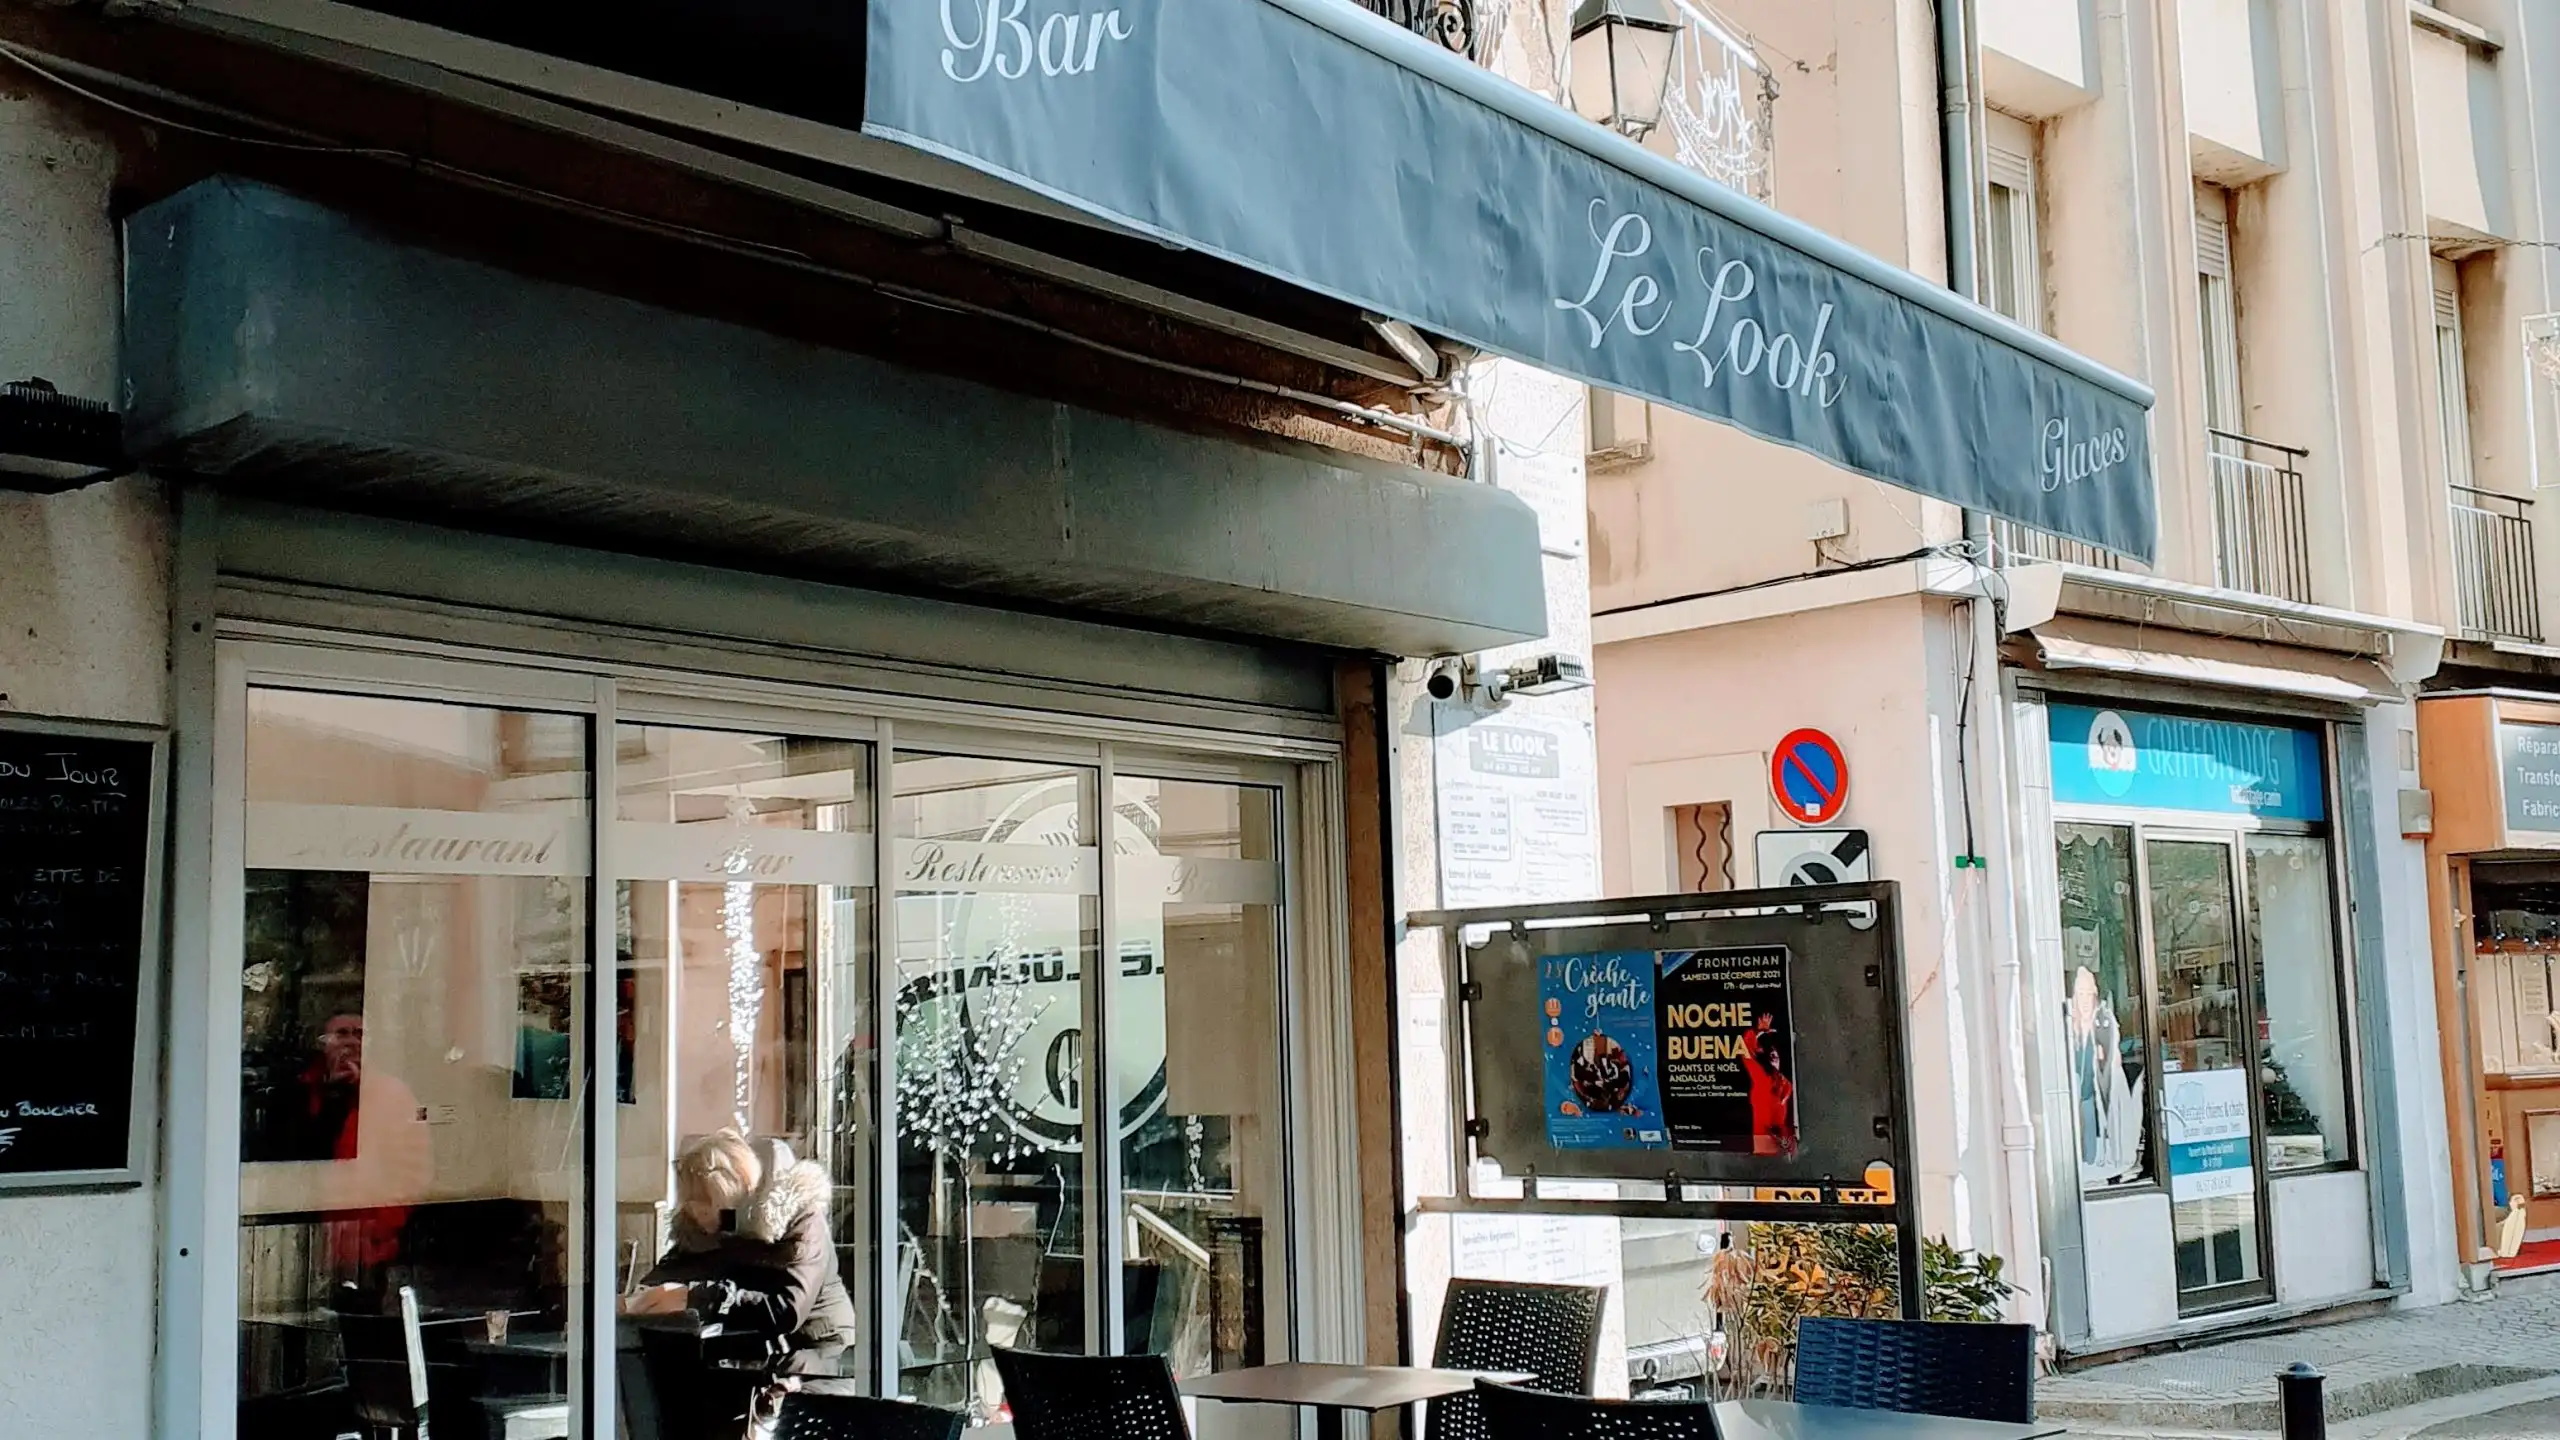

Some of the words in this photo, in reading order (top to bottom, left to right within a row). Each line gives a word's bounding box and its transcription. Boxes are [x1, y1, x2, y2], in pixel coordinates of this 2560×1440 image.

[940, 0, 1133, 82] Bar
[1555, 198, 1672, 348] Le
[1673, 246, 1848, 408] Look
[2041, 417, 2130, 493] Glaces
[1480, 728, 1499, 753] LE
[1503, 731, 1548, 757] LOOK
[2147, 717, 2234, 782] GRIFFON
[2241, 728, 2280, 786] DOG
[1681, 973, 1710, 982] SAMEDI
[1720, 968, 1761, 981] DÉCEMBRE
[1762, 970, 1781, 979] 2021
[1697, 955, 1779, 969] FRONTIGNAN
[1584, 978, 1652, 1018] géante
[1667, 1002, 1753, 1029] NOCHE
[1667, 1034, 1753, 1061] BUENA
[1668, 1063, 1702, 1073] CHANTS
[1704, 1063, 1715, 1072] DE
[1717, 1061, 1740, 1072] NOËL
[1669, 1074, 1717, 1083] ANDALOUS
[15, 1100, 99, 1117] BOUCHER
